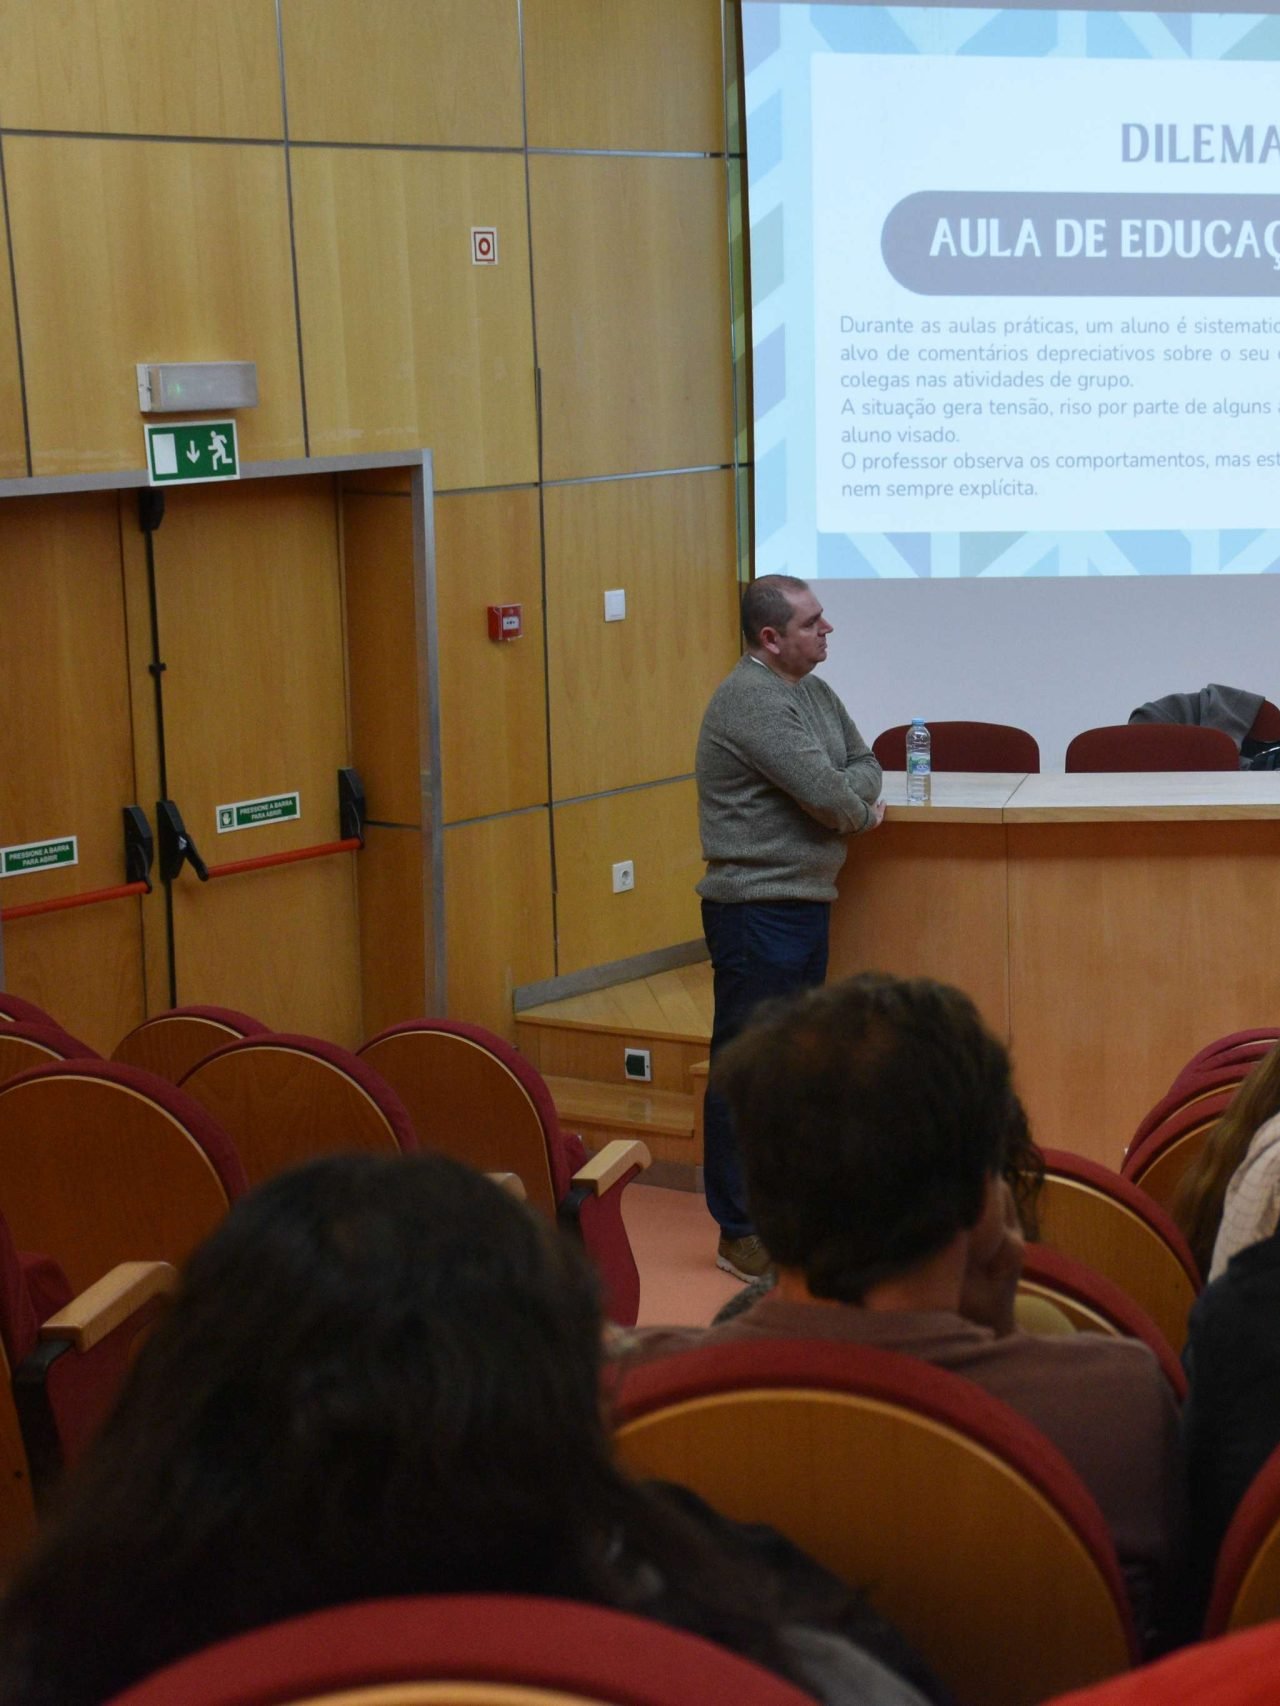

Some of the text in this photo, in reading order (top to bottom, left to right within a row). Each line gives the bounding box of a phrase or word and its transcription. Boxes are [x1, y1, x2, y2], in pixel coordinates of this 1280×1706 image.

[930, 218, 1041, 257] AULA
[1056, 219, 1107, 257] DE
[840, 315, 914, 334] Durante
[921, 321, 941, 334] as
[948, 317, 996, 334] aulas
[1004, 315, 1078, 337] práticas,
[1086, 321, 1113, 334] um
[1120, 317, 1170, 334] aluno
[1177, 316, 1187, 334] é
[841, 344, 878, 361] alvo
[886, 344, 910, 361] de
[918, 343, 1028, 361] comentários
[1036, 344, 1155, 364] depreciativos
[1163, 344, 1213, 361] sobre
[1220, 349, 1231, 361] o
[1240, 349, 1269, 361] seu
[840, 370, 1134, 392] colegas nas atividades de grupo.
[841, 398, 855, 415] A
[862, 398, 936, 419] situação
[942, 402, 982, 419] gera
[989, 397, 1053, 416] tensão,
[1060, 398, 1092, 415] riso
[1098, 402, 1128, 418] por
[1133, 400, 1179, 418] parte
[1185, 398, 1207, 414] de
[1213, 397, 1271, 418] alguns
[841, 426, 960, 443] aluno visado.
[841, 451, 856, 470] O
[862, 452, 948, 473] professor
[953, 452, 1024, 469] observa
[1030, 456, 1050, 469] os
[1056, 452, 1209, 472] comportamentos,
[1215, 454, 1251, 467] mas
[842, 478, 1037, 499] nem sempre explícita.
[240, 805, 269, 815] PRESSIONE
[275, 799, 293, 809] BARRA
[251, 812, 265, 820] PARA
[9, 848, 43, 861] PRESSIONE
[49, 844, 70, 854] BARRA
[22, 856, 39, 867] PARA
